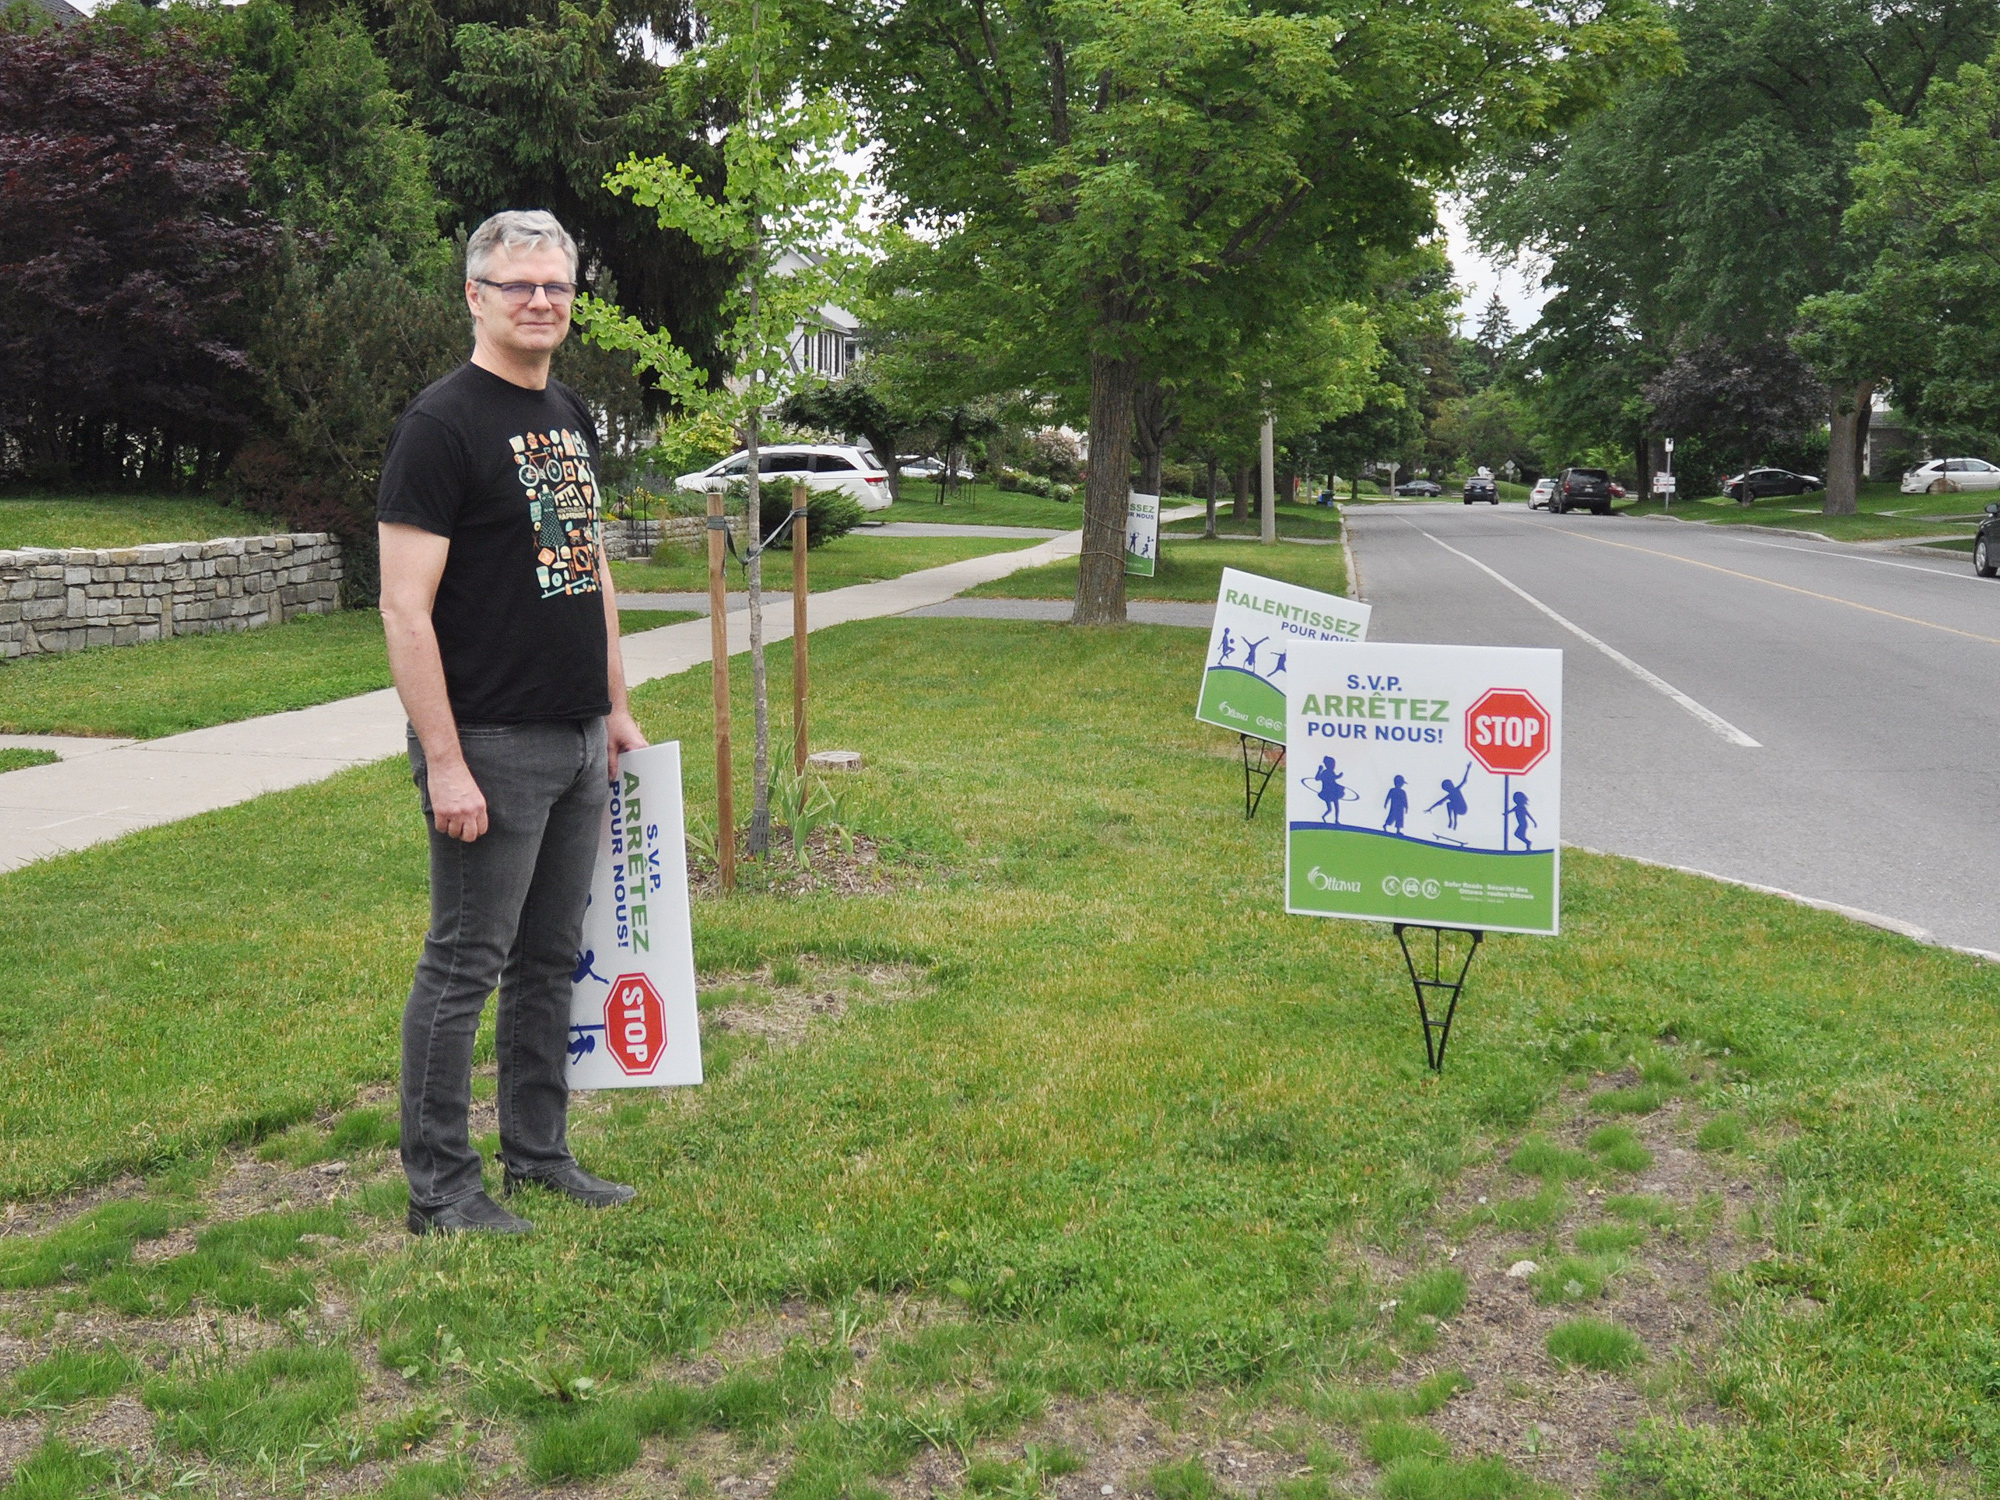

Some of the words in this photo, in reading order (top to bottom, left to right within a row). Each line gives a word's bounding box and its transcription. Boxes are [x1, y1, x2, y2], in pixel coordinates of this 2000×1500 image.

[1136, 512, 1155, 520] NOUS
[1225, 589, 1361, 638] RALENTISSEZ
[1281, 621, 1317, 639] POUR
[1320, 632, 1357, 642] NO
[1347, 674, 1402, 691] S.V.P.
[1301, 692, 1450, 722] ARRÊTEZ
[1308, 722, 1367, 739] POUR
[1375, 725, 1443, 744] NOUS!
[1475, 715, 1540, 748] STOP
[609, 780, 623, 856] POUR
[623, 771, 649, 955] ARRÊTEZ
[647, 824, 661, 893] S.V.P.
[1307, 866, 1361, 893] Ottawa
[613, 864, 629, 948] NOUS!
[622, 986, 648, 1062] STOP
